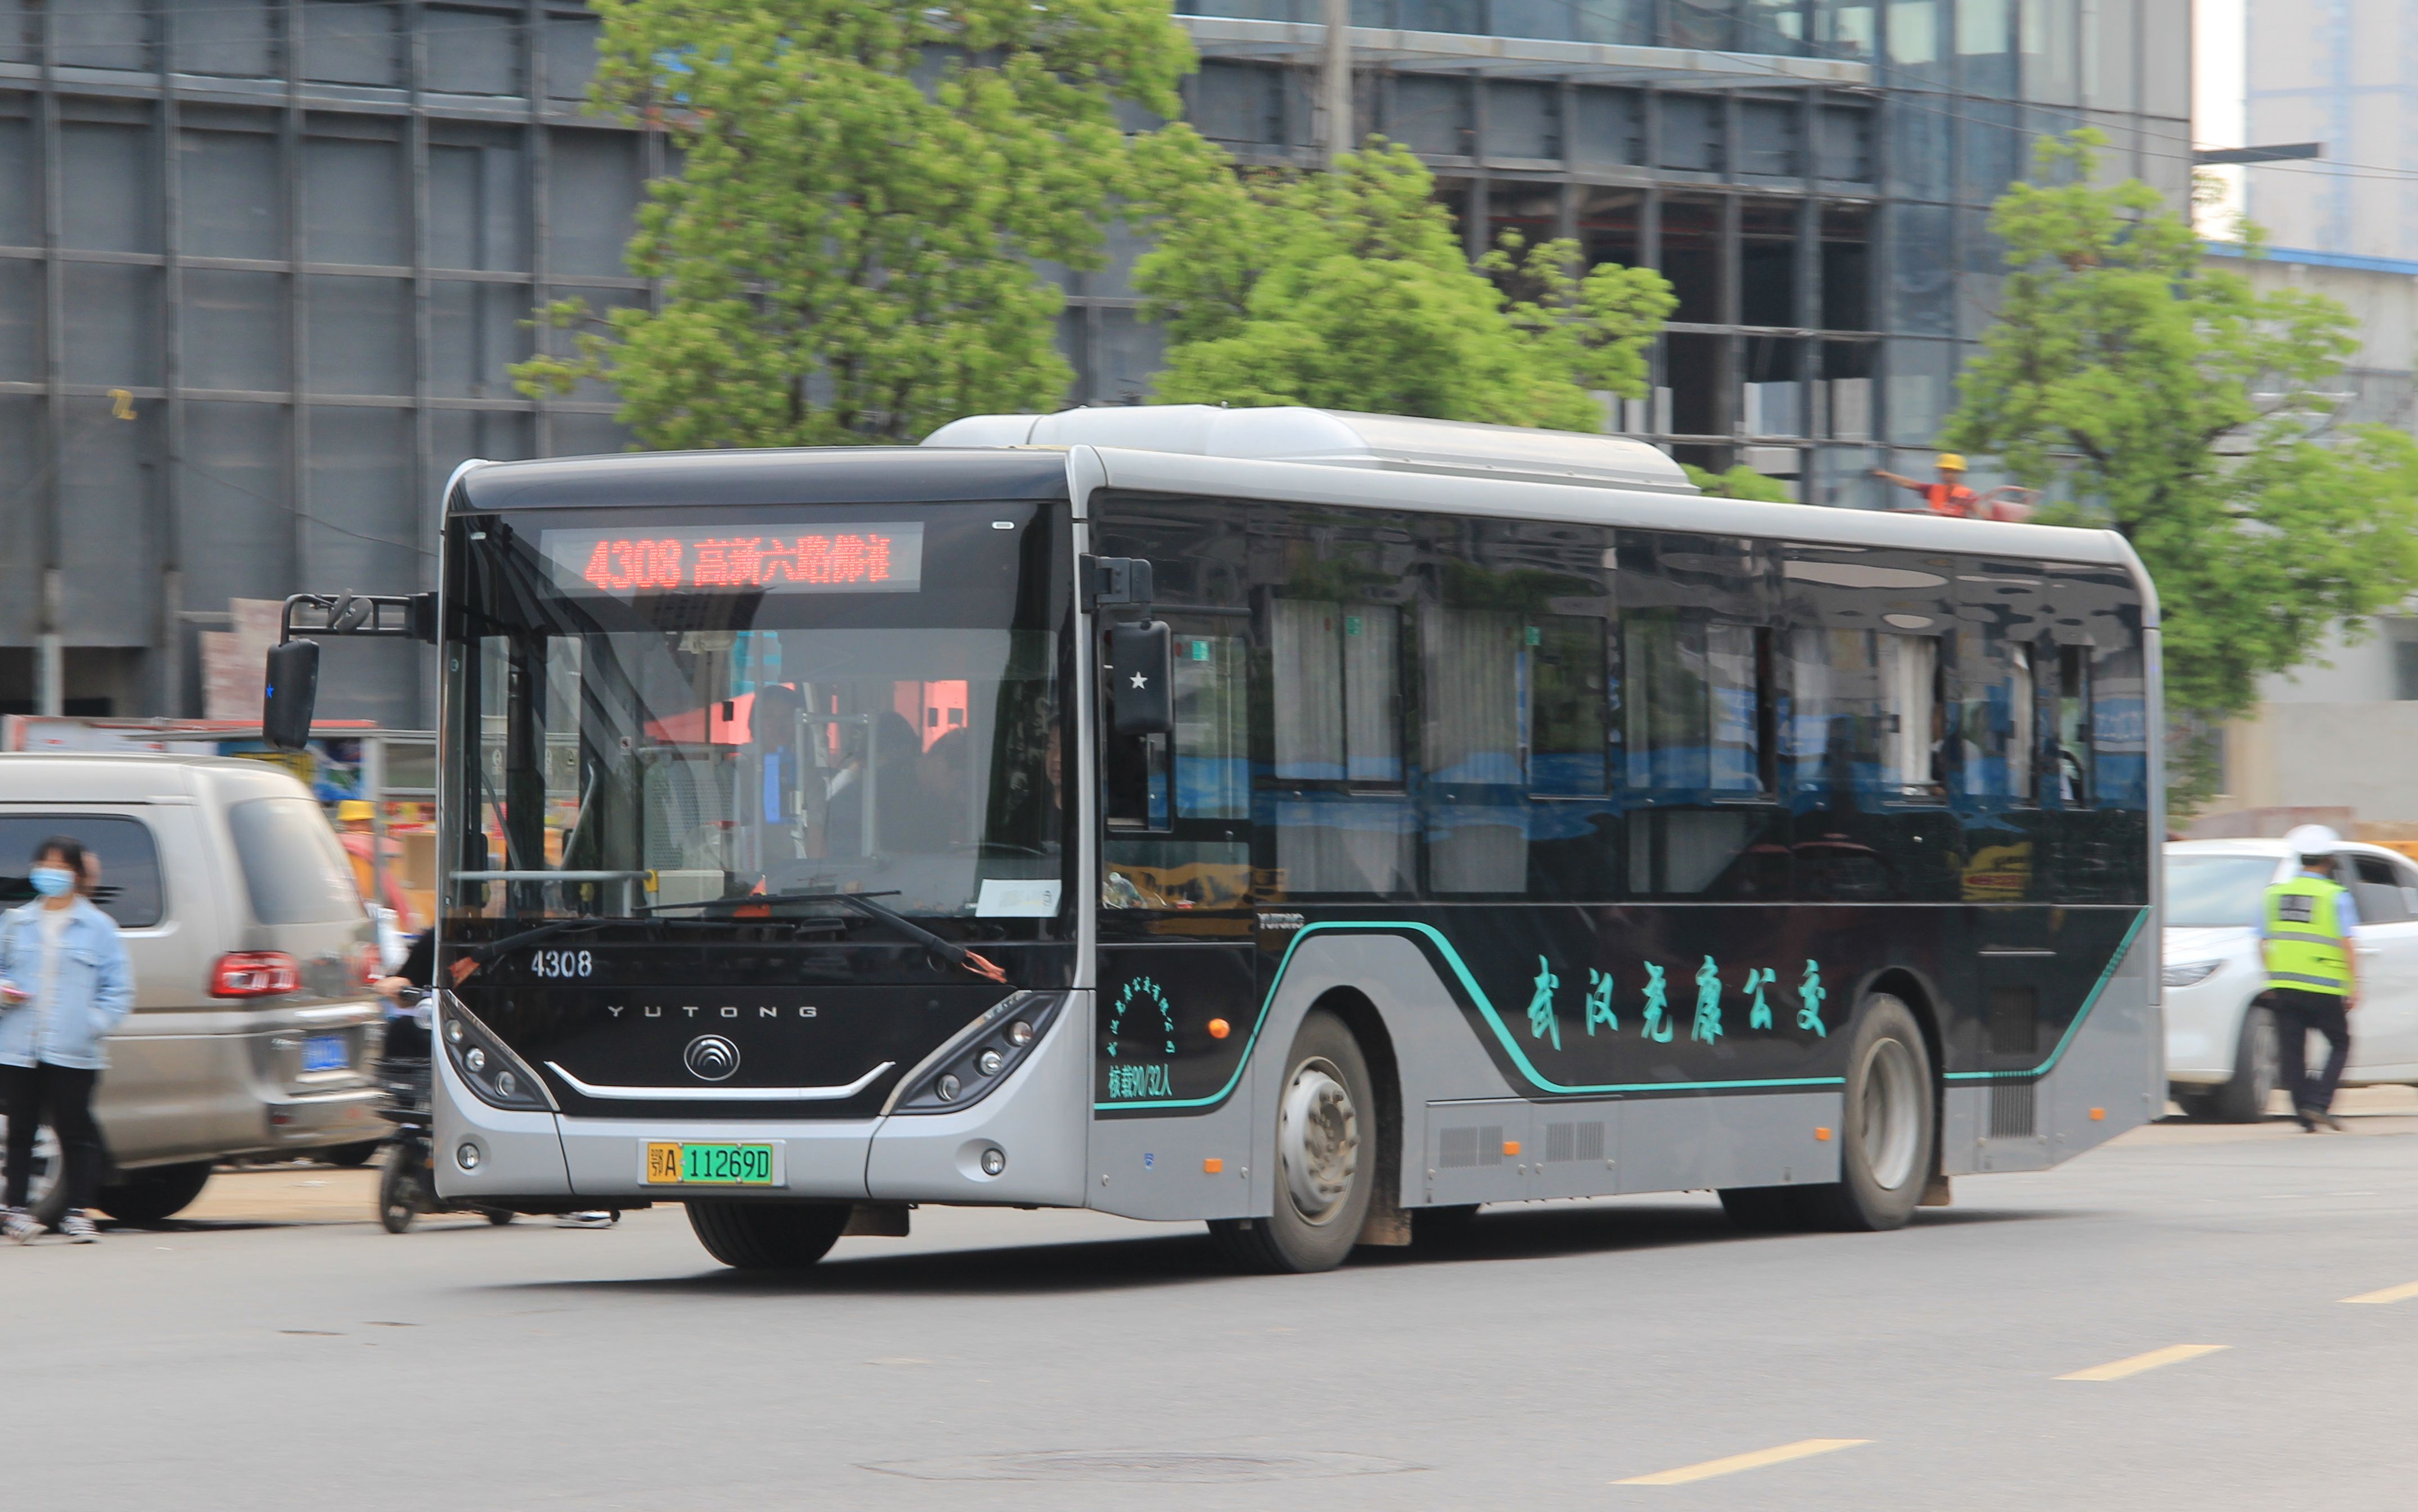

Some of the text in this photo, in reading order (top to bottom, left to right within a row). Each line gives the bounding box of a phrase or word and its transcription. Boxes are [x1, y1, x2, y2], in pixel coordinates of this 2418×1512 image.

[585, 539, 682, 589] 4308
[531, 950, 592, 977] 4308
[608, 1007, 817, 1018] YUTONG
